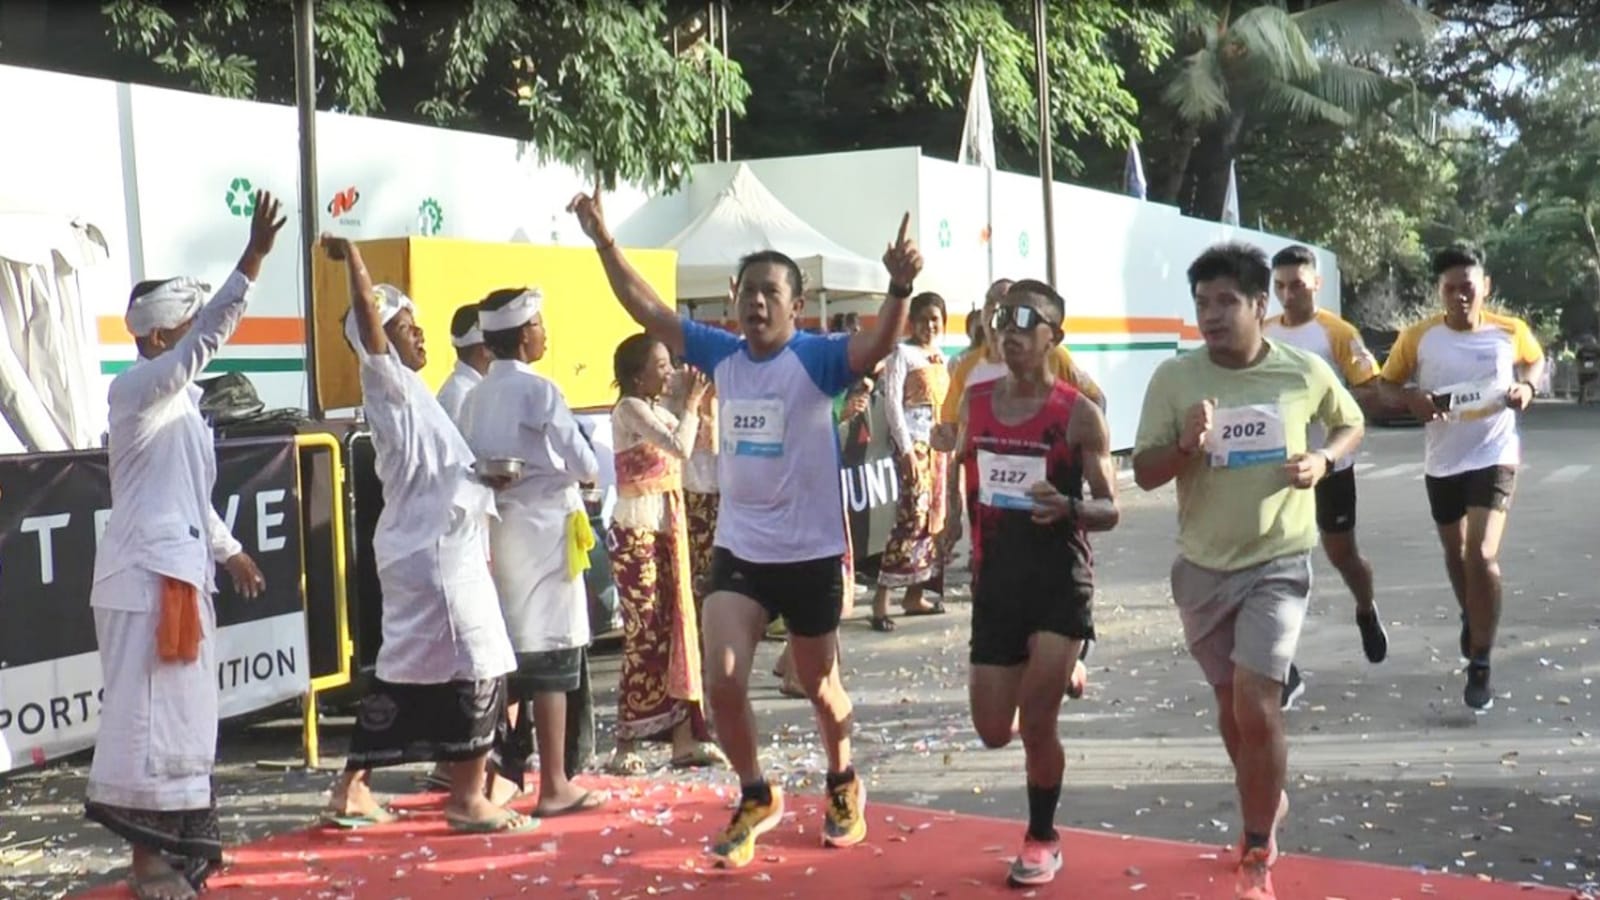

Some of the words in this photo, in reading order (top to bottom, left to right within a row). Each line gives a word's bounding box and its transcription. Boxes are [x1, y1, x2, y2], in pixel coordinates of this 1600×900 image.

[733, 415, 766, 429] 2129
[1222, 421, 1266, 440] 2002
[989, 468, 1027, 484] 2127
